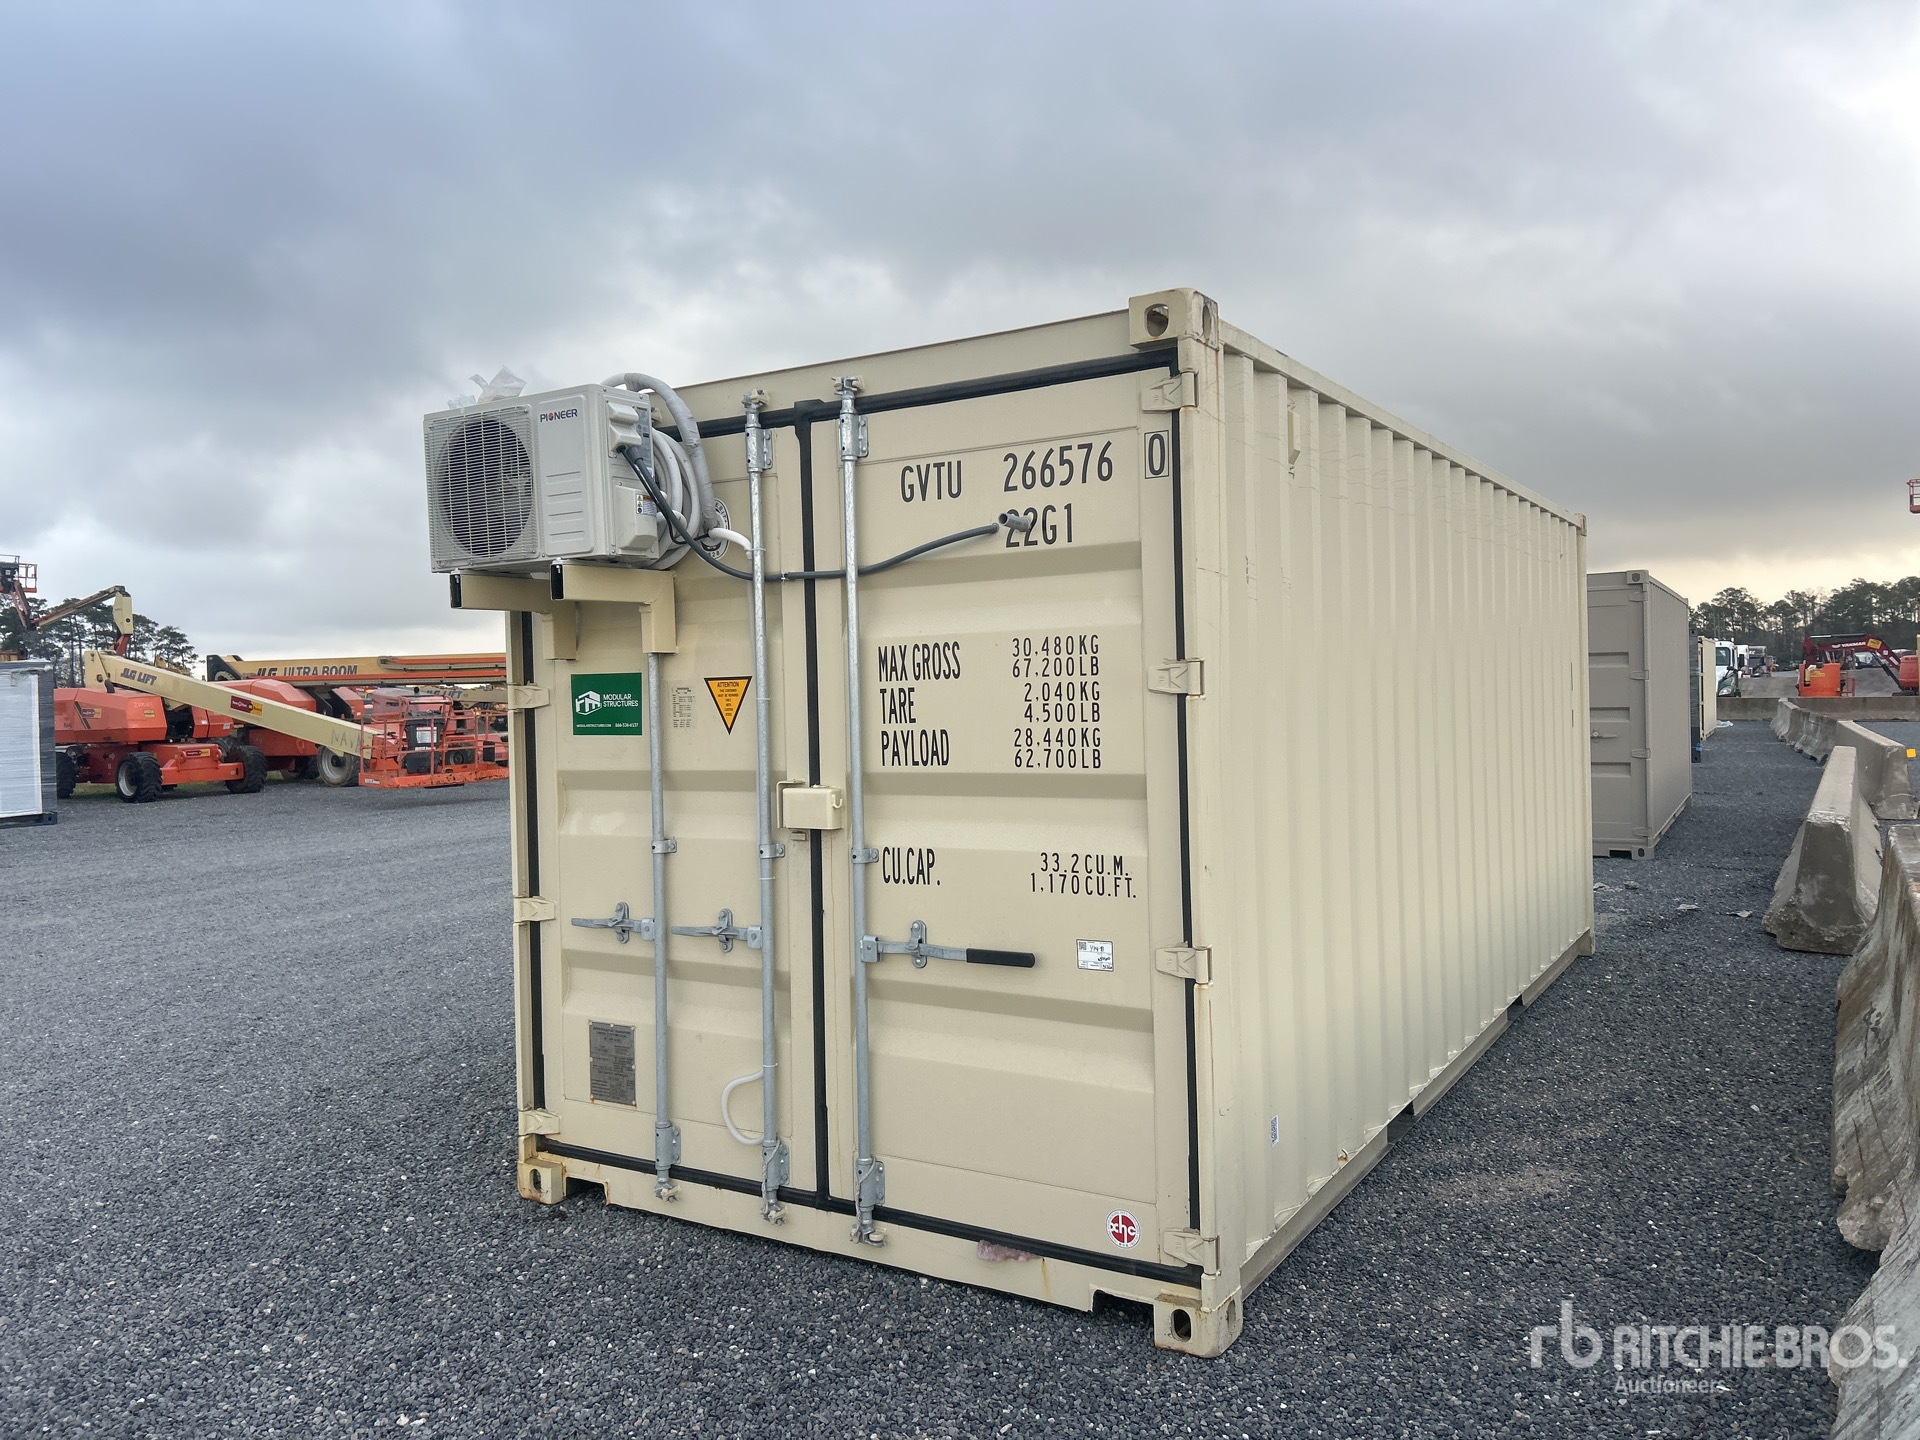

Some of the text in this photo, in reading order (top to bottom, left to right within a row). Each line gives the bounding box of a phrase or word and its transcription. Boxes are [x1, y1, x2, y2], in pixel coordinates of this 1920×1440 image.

[539, 408, 578, 423] PIONEER
[900, 433, 1166, 503] GVTU 266576 0
[1005, 502, 1073, 548] 22G1
[120, 667, 158, 686] JLG LIFT
[283, 666, 319, 677] ULTRA
[321, 664, 358, 676] BOOM
[877, 641, 961, 682] MAX GROSS
[603, 693, 632, 701] MODULAR
[603, 699, 639, 708] STRUCTURES
[880, 686, 917, 724] TARE
[881, 729, 950, 767] PAYLOAD
[882, 846, 941, 886] CU.CAP.
